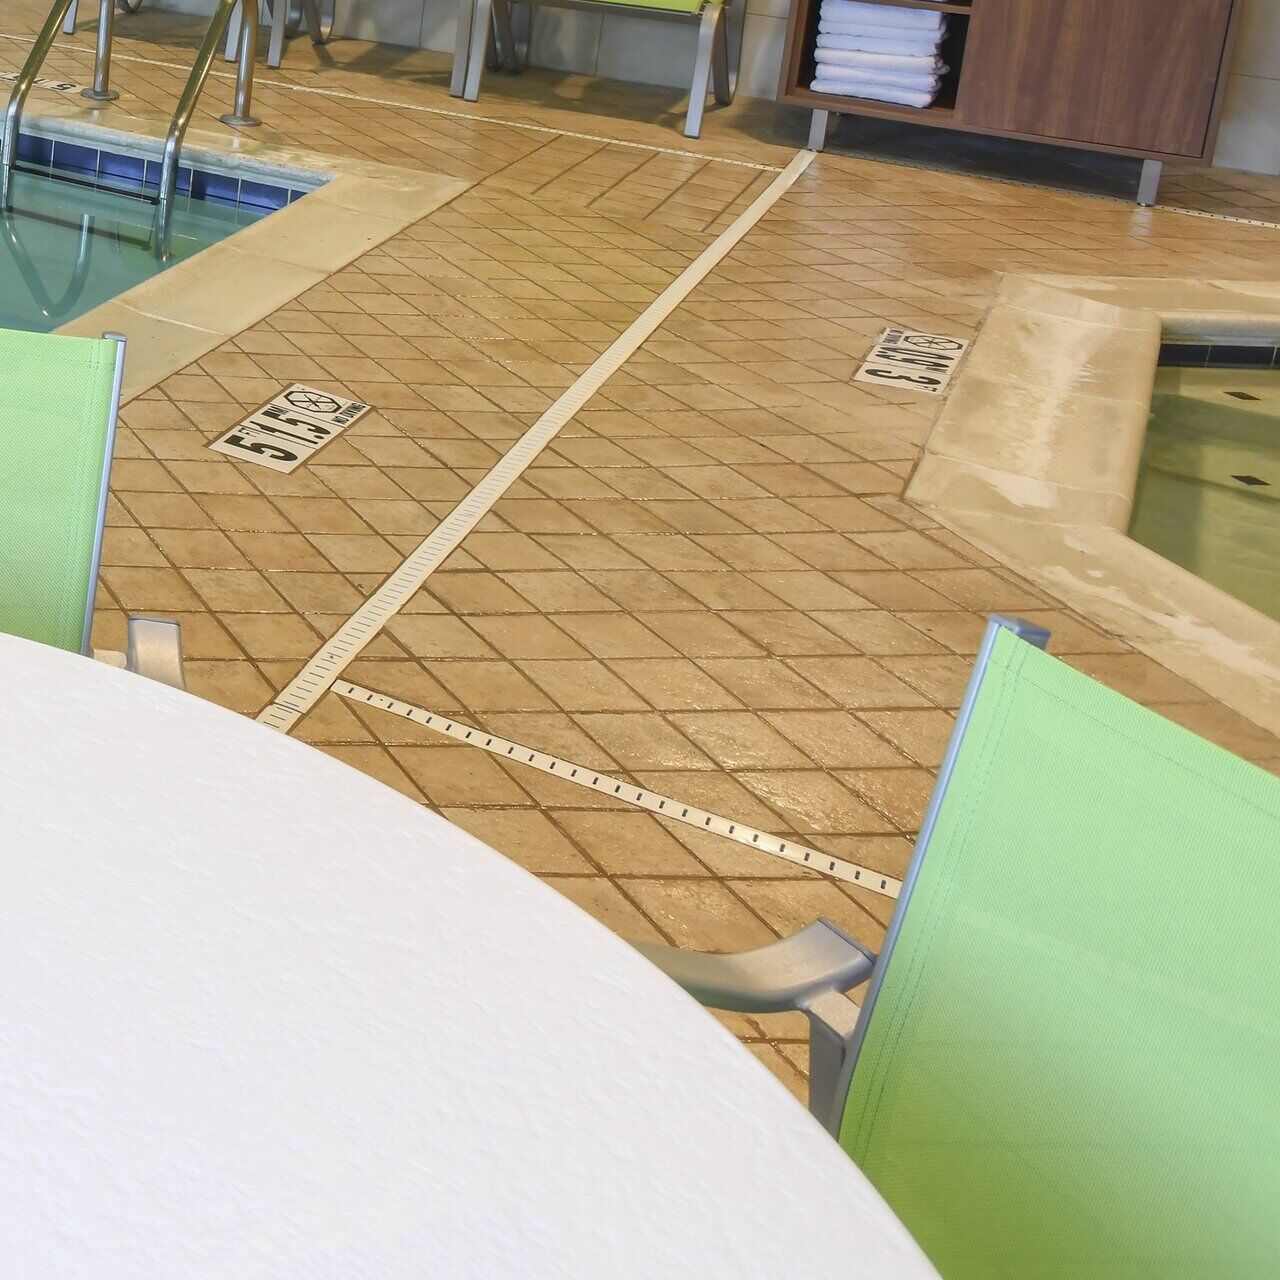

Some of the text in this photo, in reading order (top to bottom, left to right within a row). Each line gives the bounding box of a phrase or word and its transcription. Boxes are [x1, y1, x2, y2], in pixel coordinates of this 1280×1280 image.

[865, 369, 941, 385] 3
[330, 402, 367, 425] NO DIVING
[250, 411, 331, 445] 1.5
[224, 427, 298, 462] 5 FT
